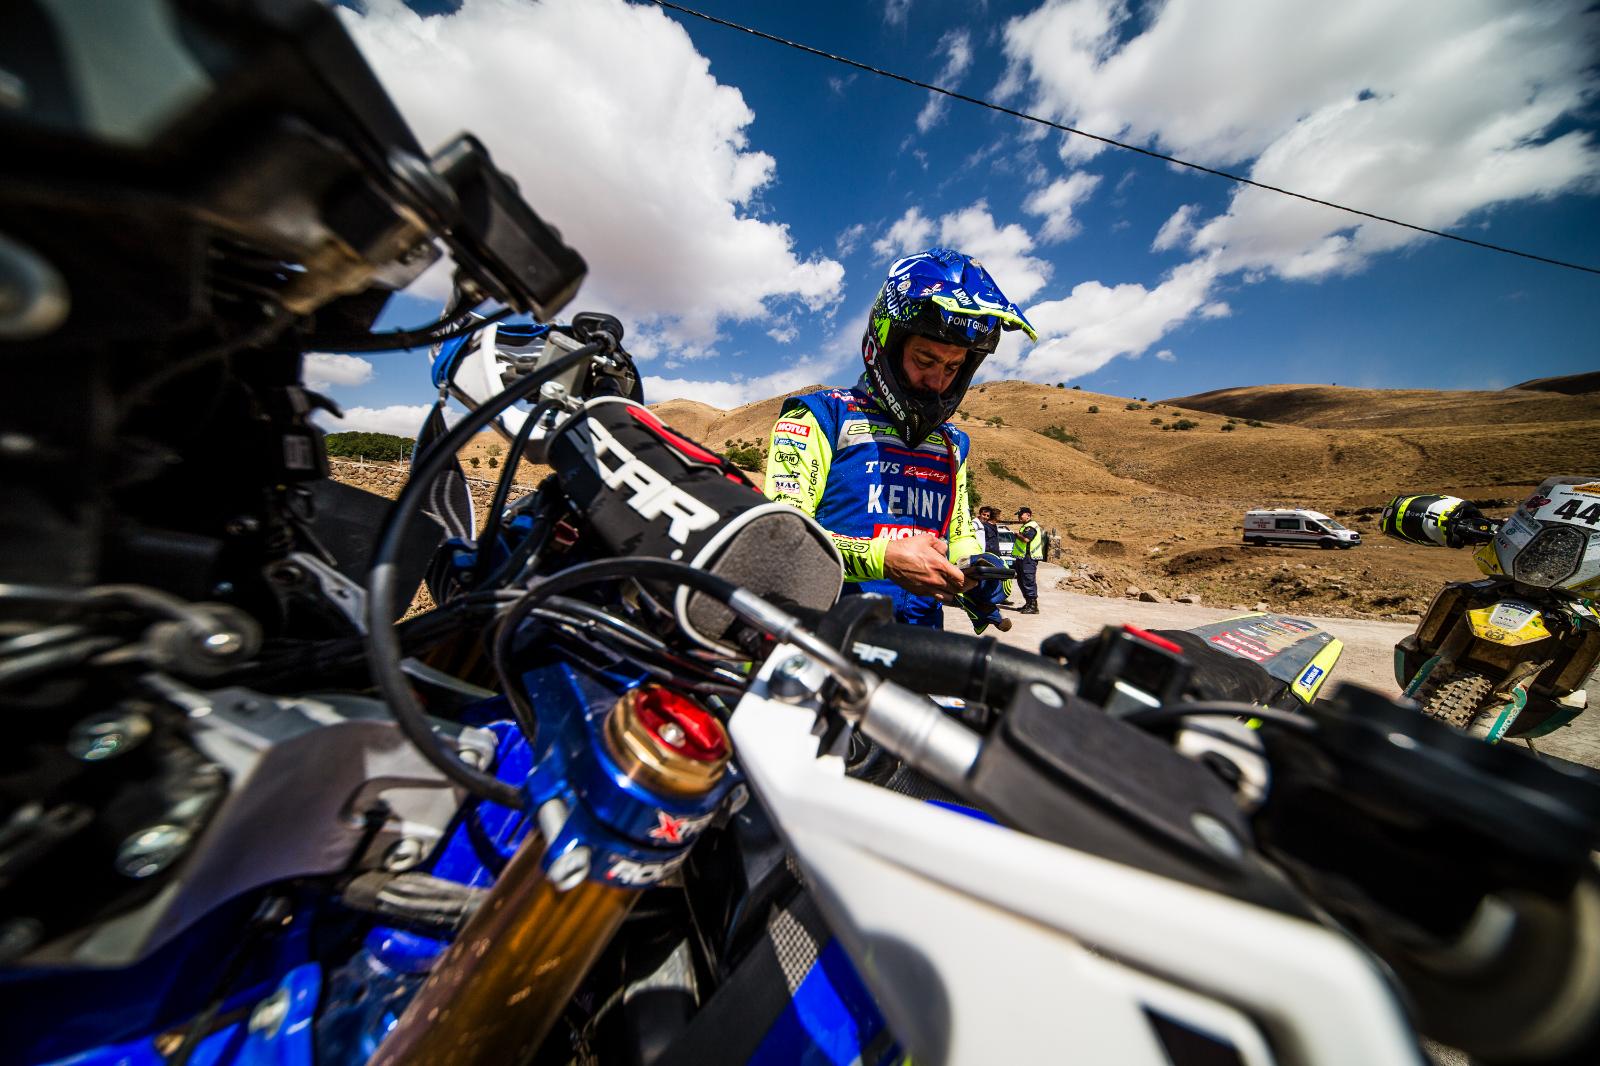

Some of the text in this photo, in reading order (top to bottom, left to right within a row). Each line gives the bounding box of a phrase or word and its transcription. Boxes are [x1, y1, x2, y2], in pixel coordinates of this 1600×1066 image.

[886, 280, 900, 317] GRUP
[947, 315, 989, 335] PONT GRUP
[776, 422, 808, 437] MOTUL
[564, 416, 720, 546] SCAR
[809, 459, 820, 486] GRUP
[865, 460, 950, 482] TVS Racing
[775, 481, 800, 489] MAC
[867, 483, 947, 522] KENNY
[1553, 498, 1600, 525] 44
[1495, 704, 1522, 740] MOTOREX
